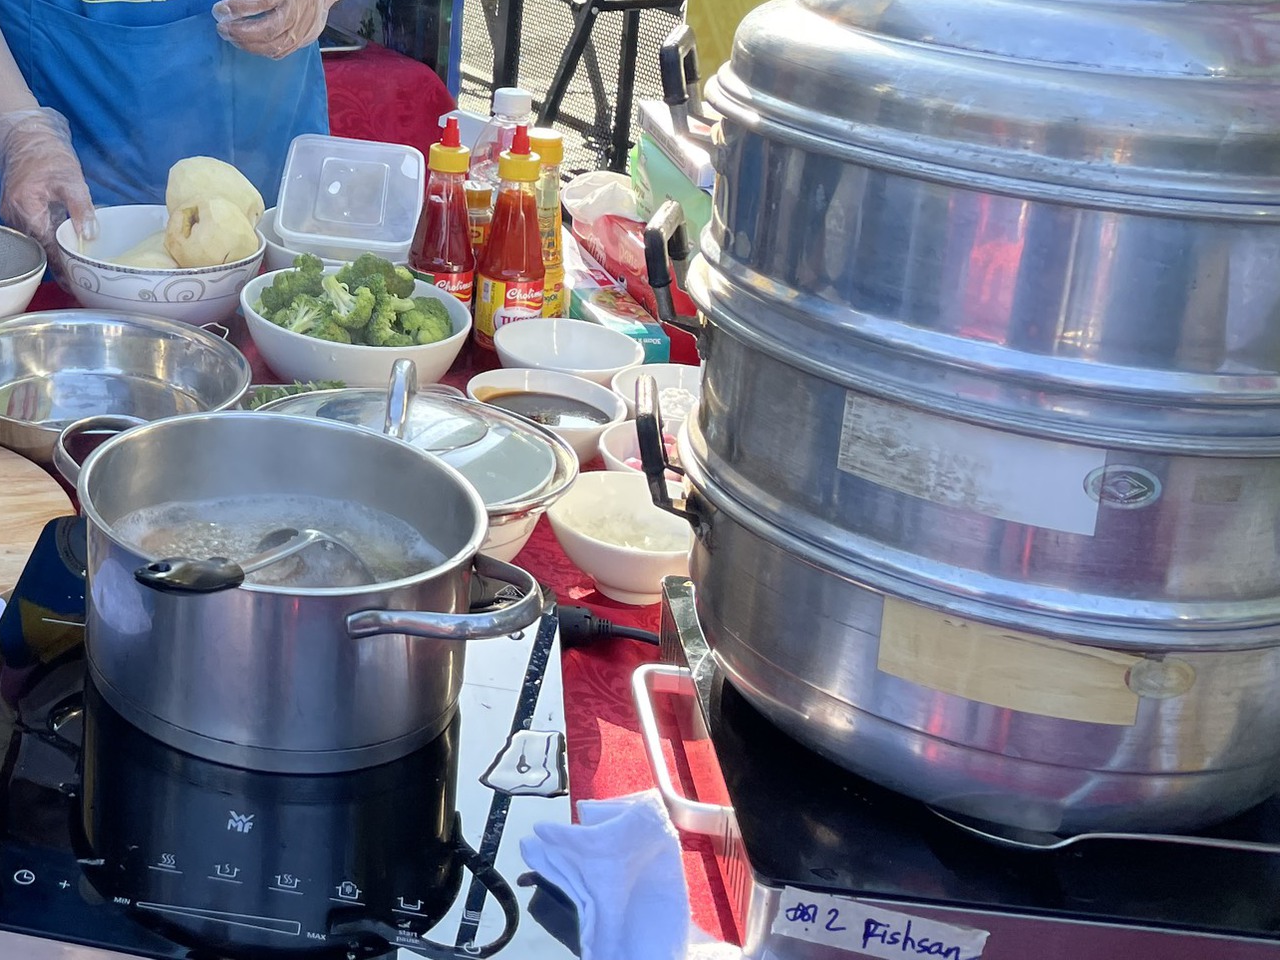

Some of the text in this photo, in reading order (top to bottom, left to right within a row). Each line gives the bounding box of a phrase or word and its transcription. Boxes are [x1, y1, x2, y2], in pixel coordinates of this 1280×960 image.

[227, 810, 255, 833] WMF
[113, 896, 131, 905] MIN
[825, 908, 846, 932] 2
[306, 931, 327, 941] MAX
[398, 930, 418, 938] start
[395, 936, 421, 944] pause
